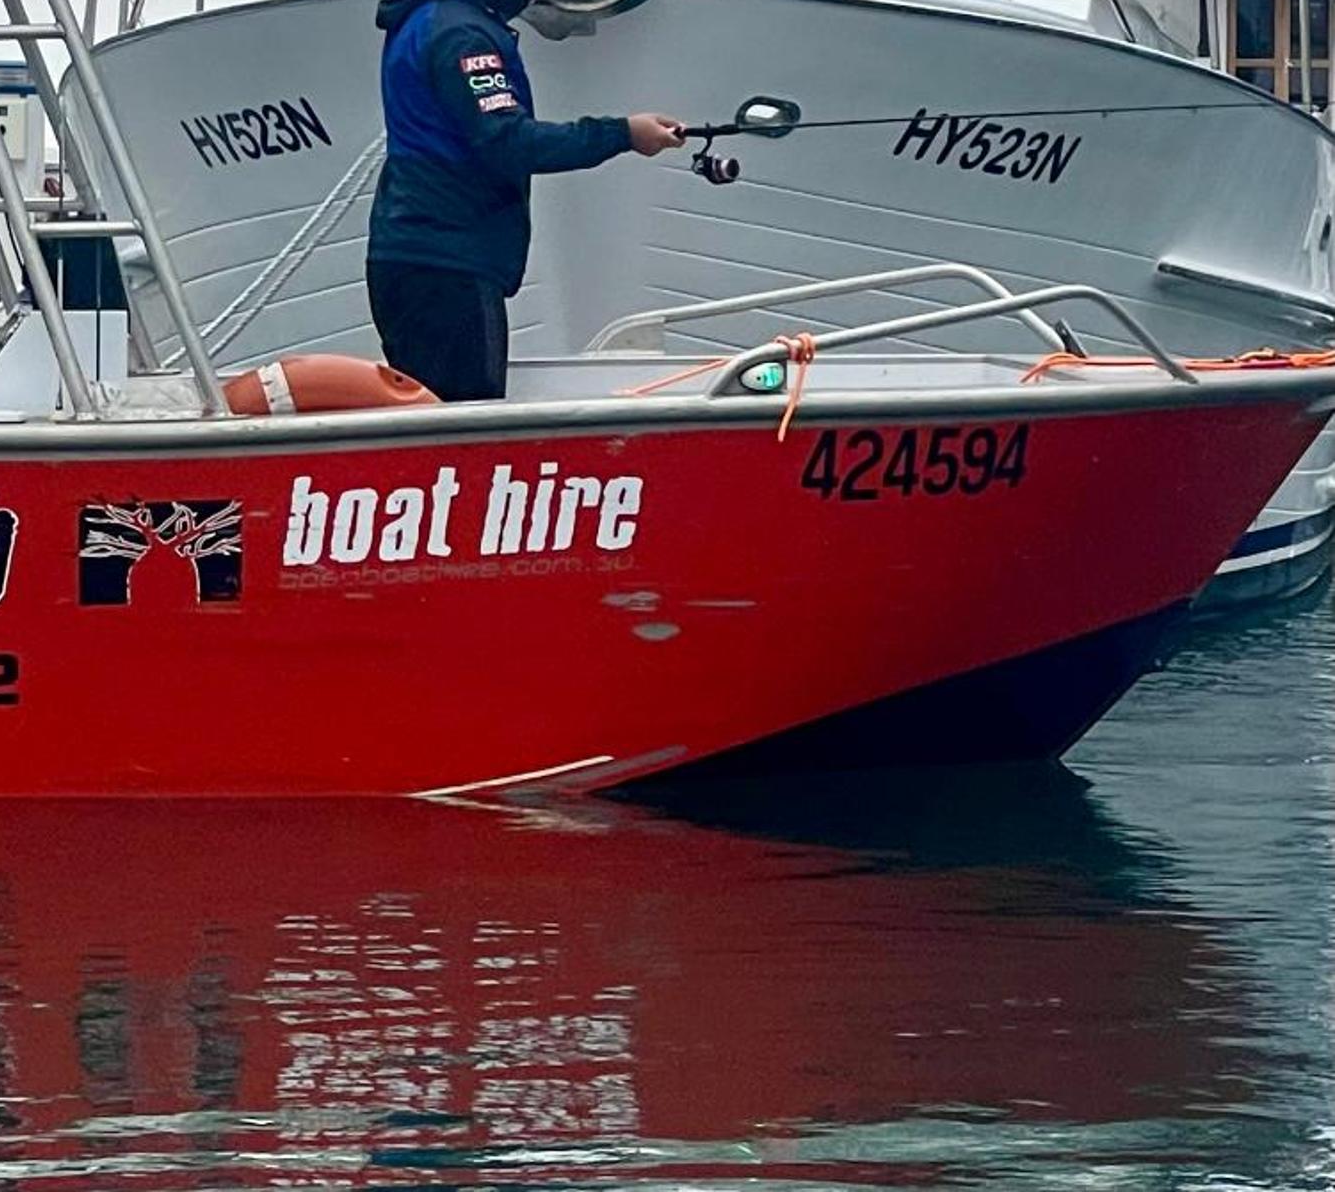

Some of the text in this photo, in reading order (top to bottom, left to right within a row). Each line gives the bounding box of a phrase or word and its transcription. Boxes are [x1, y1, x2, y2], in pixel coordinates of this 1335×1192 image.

[465, 55, 498, 72] KFC
[180, 97, 332, 168] HY523N
[893, 108, 1082, 184] HY523N
[801, 423, 1029, 501] 424594
[282, 466, 460, 566] boat
[480, 462, 644, 556] hire
